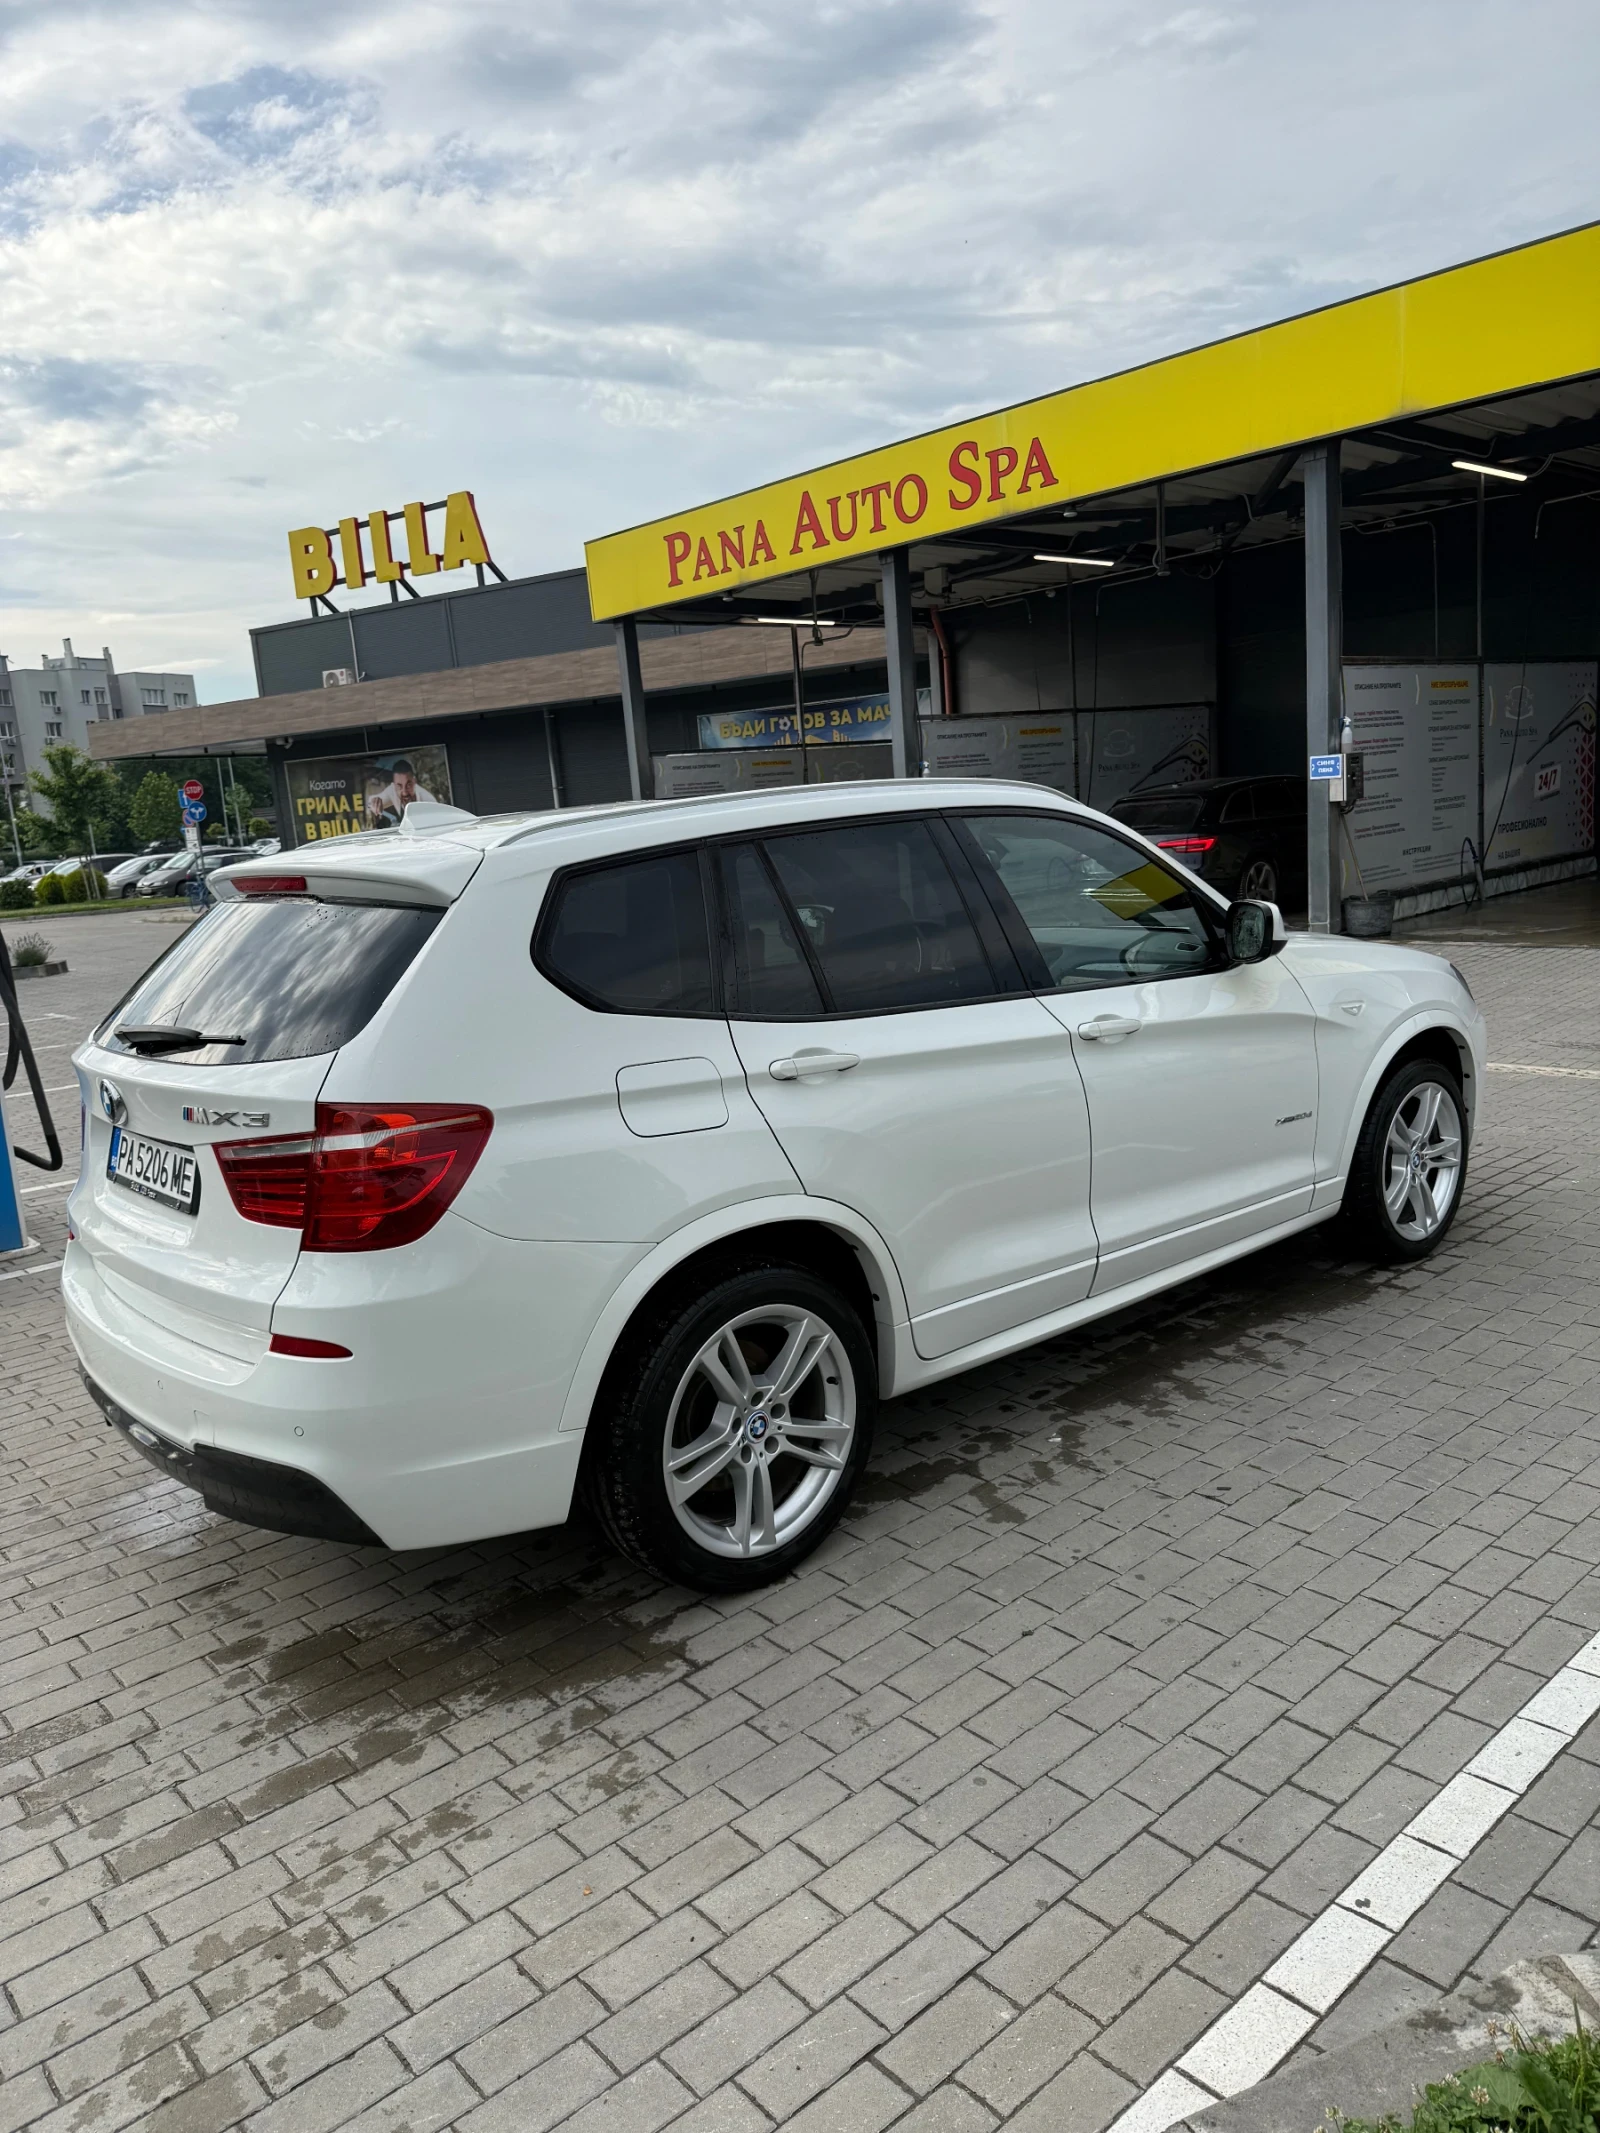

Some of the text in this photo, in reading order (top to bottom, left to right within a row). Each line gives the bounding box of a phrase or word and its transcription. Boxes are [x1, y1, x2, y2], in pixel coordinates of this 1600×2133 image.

[663, 437, 1058, 588] PANA AUTO SPA
[288, 491, 490, 599] BILLA
[720, 718, 764, 738] БЪДИ
[830, 709, 852, 726] ЗА
[186, 786, 201, 794] STOP
[309, 780, 346, 791] Когато
[1538, 769, 1557, 790] 24/7
[297, 794, 364, 816] ГРИЛА Е
[1498, 816, 1547, 834] ПРОФЕСИОНАЛНО
